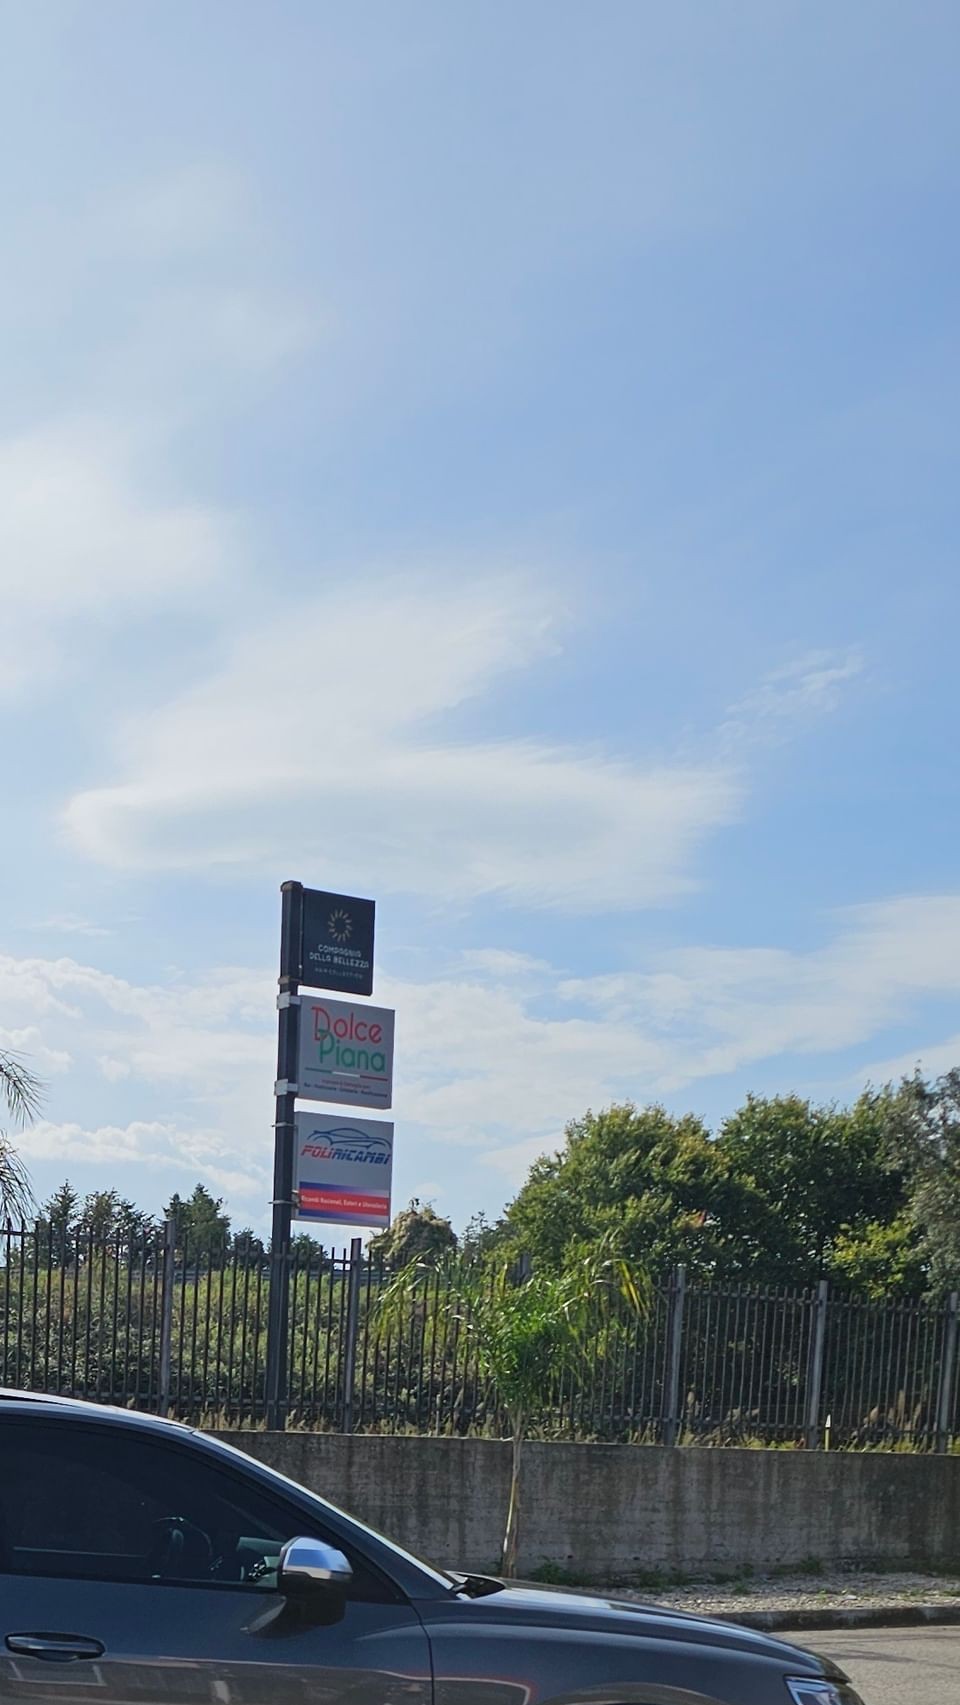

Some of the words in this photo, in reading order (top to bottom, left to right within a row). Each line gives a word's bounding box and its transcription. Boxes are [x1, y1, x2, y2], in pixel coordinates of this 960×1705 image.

[311, 1006, 382, 1044] Dolce
[318, 1028, 386, 1073] Piana
[300, 1144, 391, 1165] POLIRICAMBI
